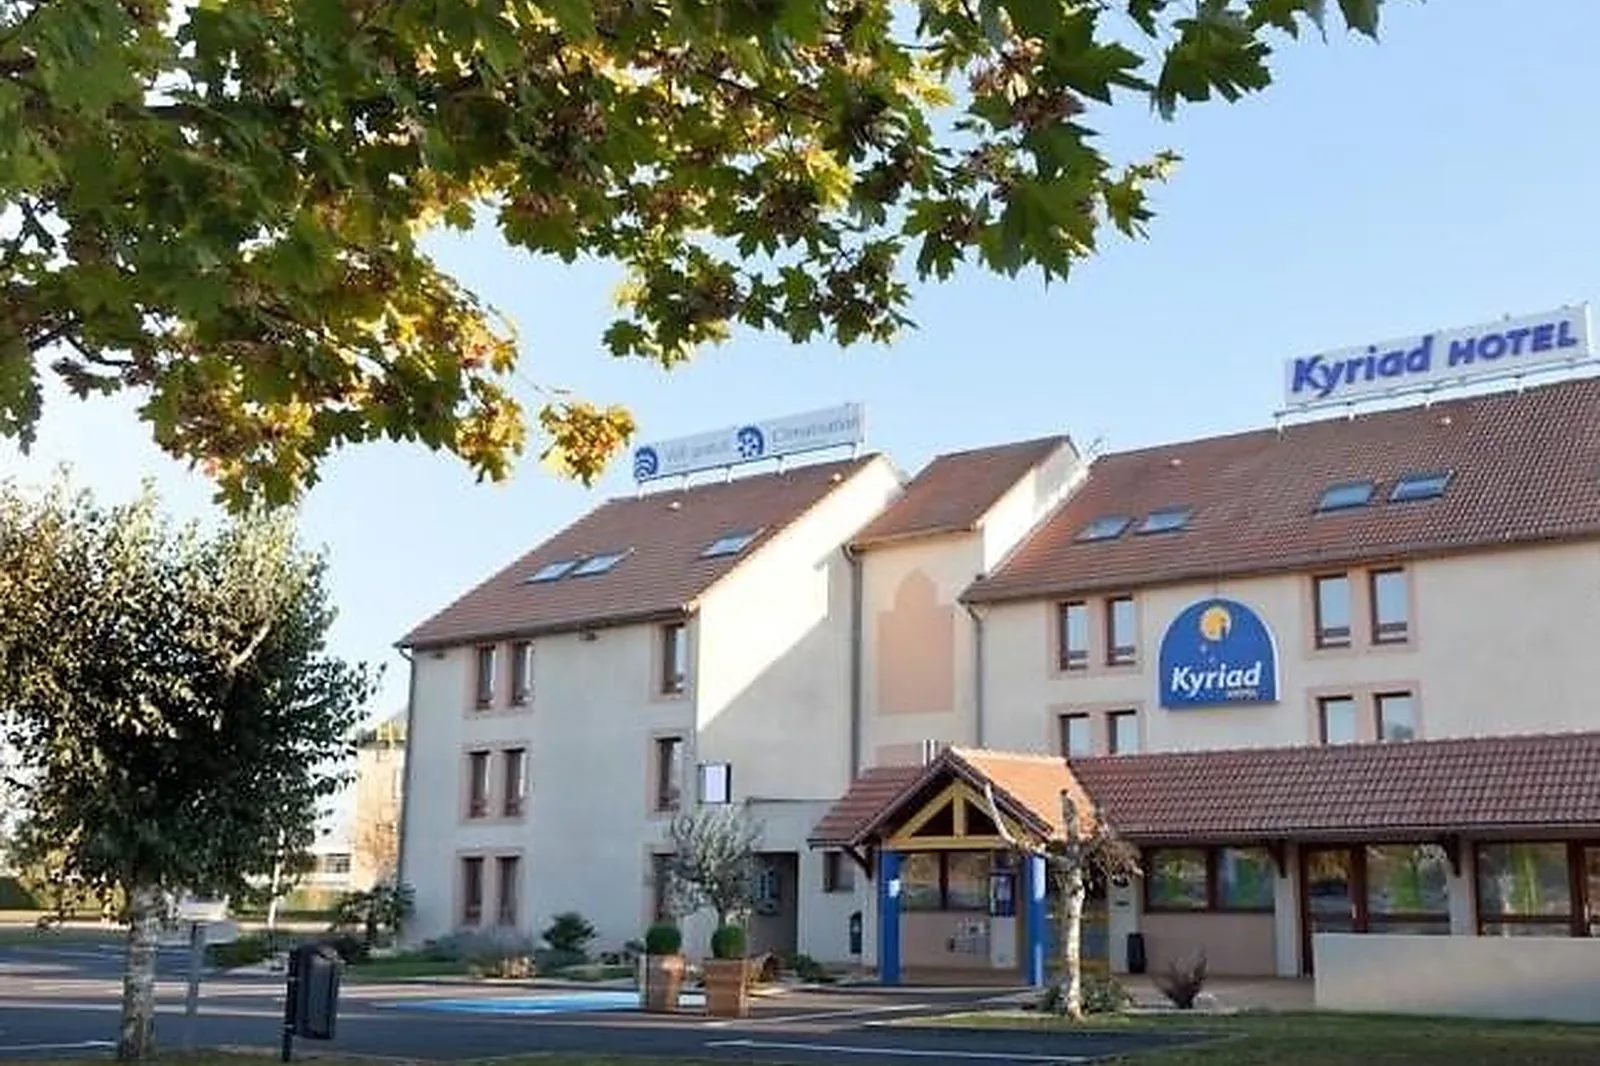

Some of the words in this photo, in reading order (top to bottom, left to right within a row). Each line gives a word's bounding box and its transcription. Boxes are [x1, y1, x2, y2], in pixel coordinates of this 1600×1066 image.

[1291, 334, 1434, 398] Kyriad
[1448, 320, 1578, 367] HOTEL
[1170, 660, 1262, 698] Kyriad
